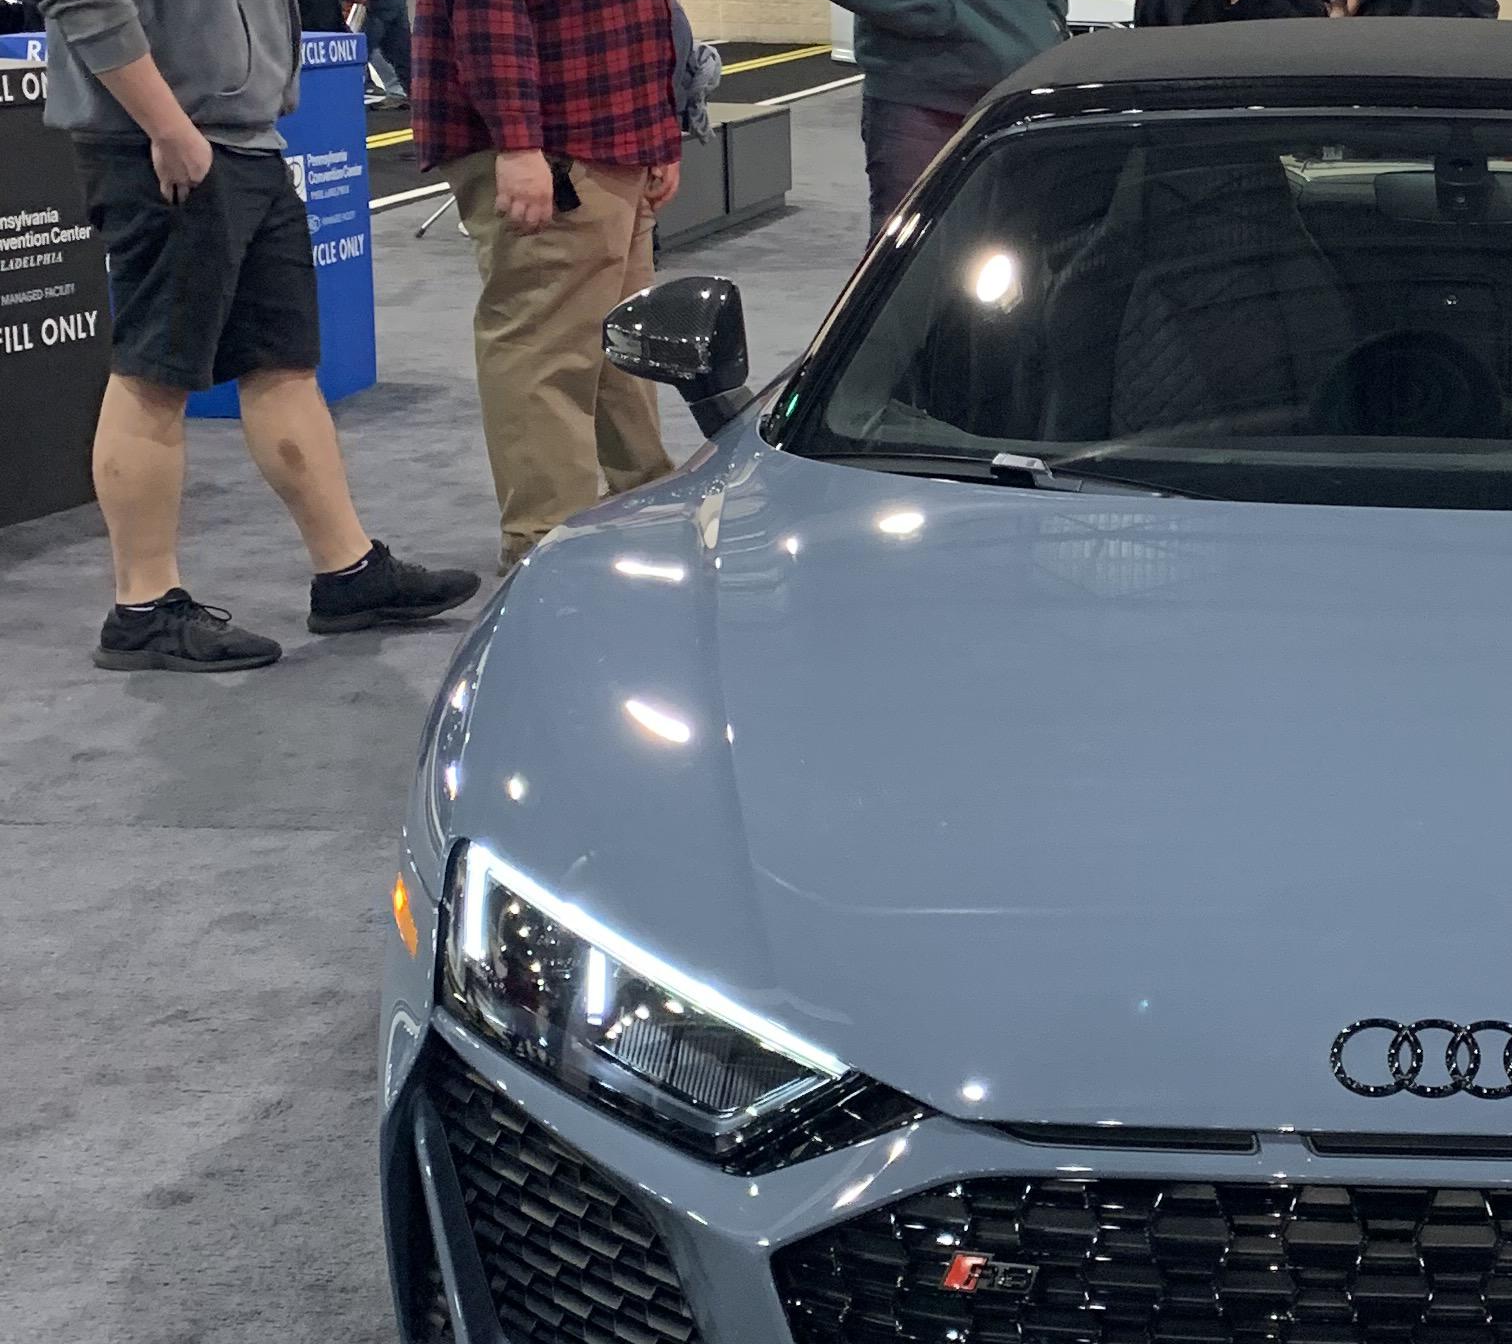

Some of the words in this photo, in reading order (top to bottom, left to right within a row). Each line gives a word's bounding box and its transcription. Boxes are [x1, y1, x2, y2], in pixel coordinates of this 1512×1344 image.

[27, 40, 48, 62] R
[328, 39, 357, 63] ONLY
[50, 225, 92, 244] Center
[339, 233, 365, 261] ONLY
[41, 310, 98, 346] ONLY
